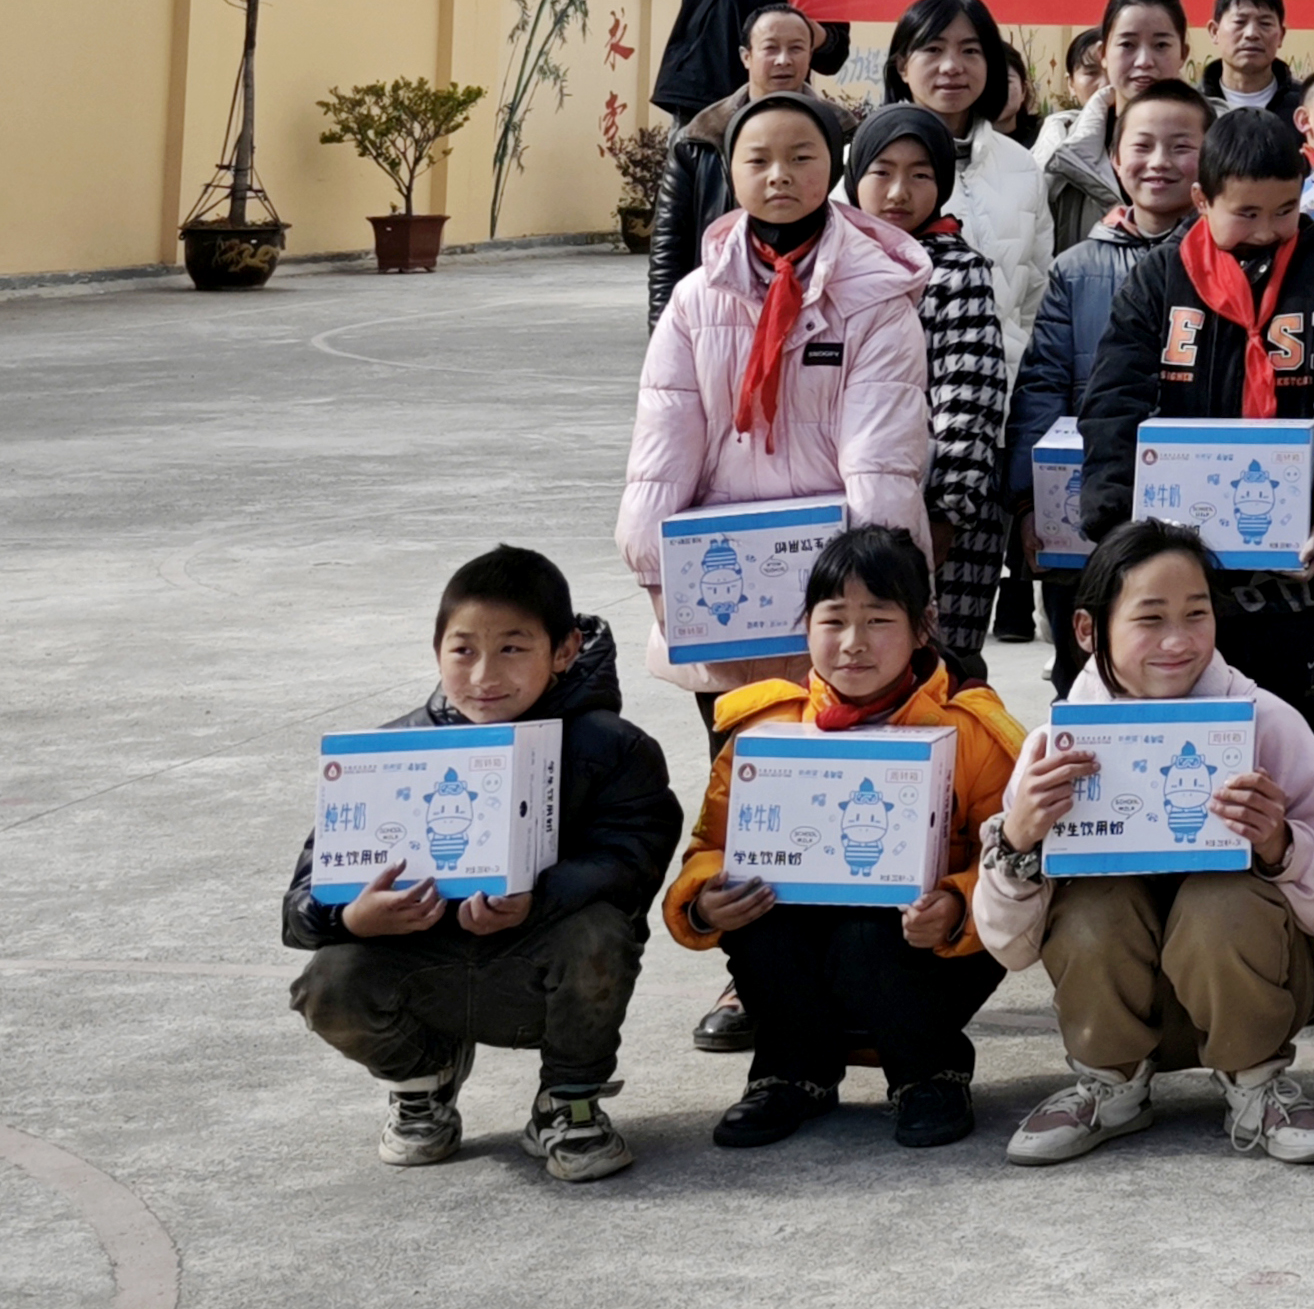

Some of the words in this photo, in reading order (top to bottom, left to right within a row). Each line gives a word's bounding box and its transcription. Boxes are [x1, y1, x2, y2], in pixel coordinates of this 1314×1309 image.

[1161, 306, 1205, 366] E
[1143, 484, 1181, 508] 纯牛奶
[1072, 775, 1101, 802] 牛奶
[324, 802, 367, 832] 纯牛奶
[738, 804, 782, 832] 纯牛奶
[1052, 821, 1124, 837] 学生饮用奶
[320, 850, 389, 868] 学生饮用奶
[733, 851, 802, 866] 学生饮用奶
